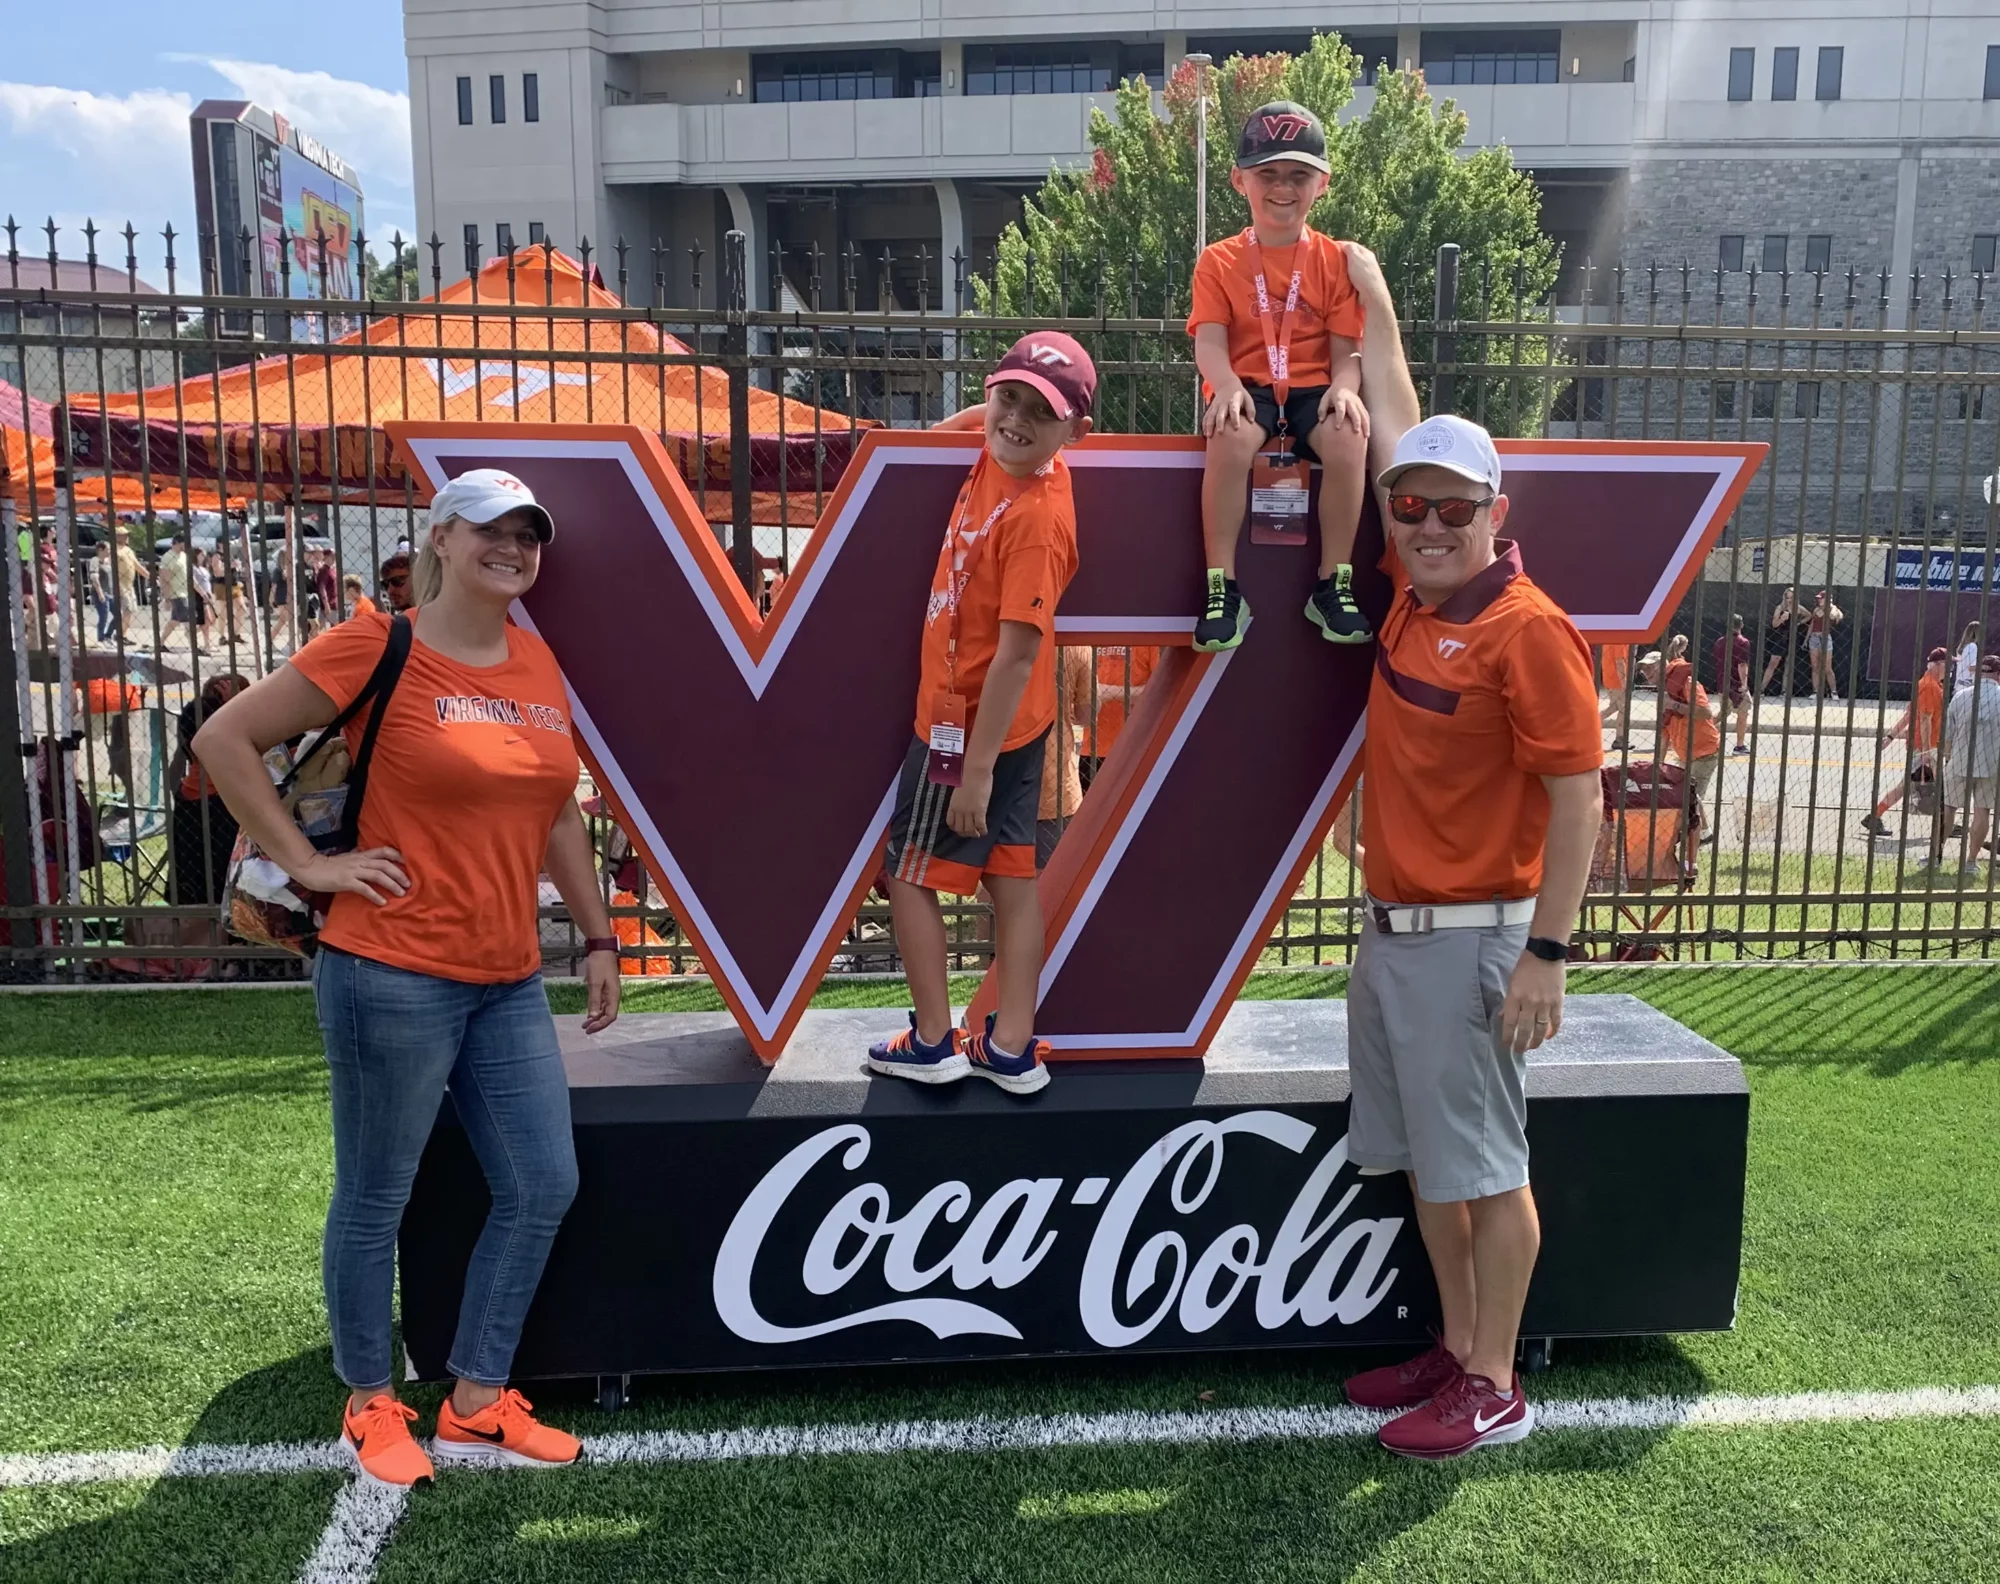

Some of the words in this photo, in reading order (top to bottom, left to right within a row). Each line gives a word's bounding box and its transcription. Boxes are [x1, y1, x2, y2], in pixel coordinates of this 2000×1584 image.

[1262, 114, 1312, 140] VT
[295, 128, 328, 172] VIRGINIA
[327, 148, 344, 180] TECH
[1255, 273, 1269, 313] HOKIES
[1286, 270, 1301, 312] HOKIES
[1030, 343, 1073, 365] VT
[1279, 345, 1288, 380] HOKIES
[421, 357, 607, 407] VT
[202, 428, 408, 478] VIRGINI
[493, 479, 523, 491] VT
[979, 497, 1012, 537] HOKIES
[1437, 637, 1467, 659] VT
[435, 696, 527, 725] VIRGINIA
[522, 703, 571, 738] TECH
[382, 420, 1768, 1067] VT
[712, 1110, 1404, 1347] Coca-Cola
